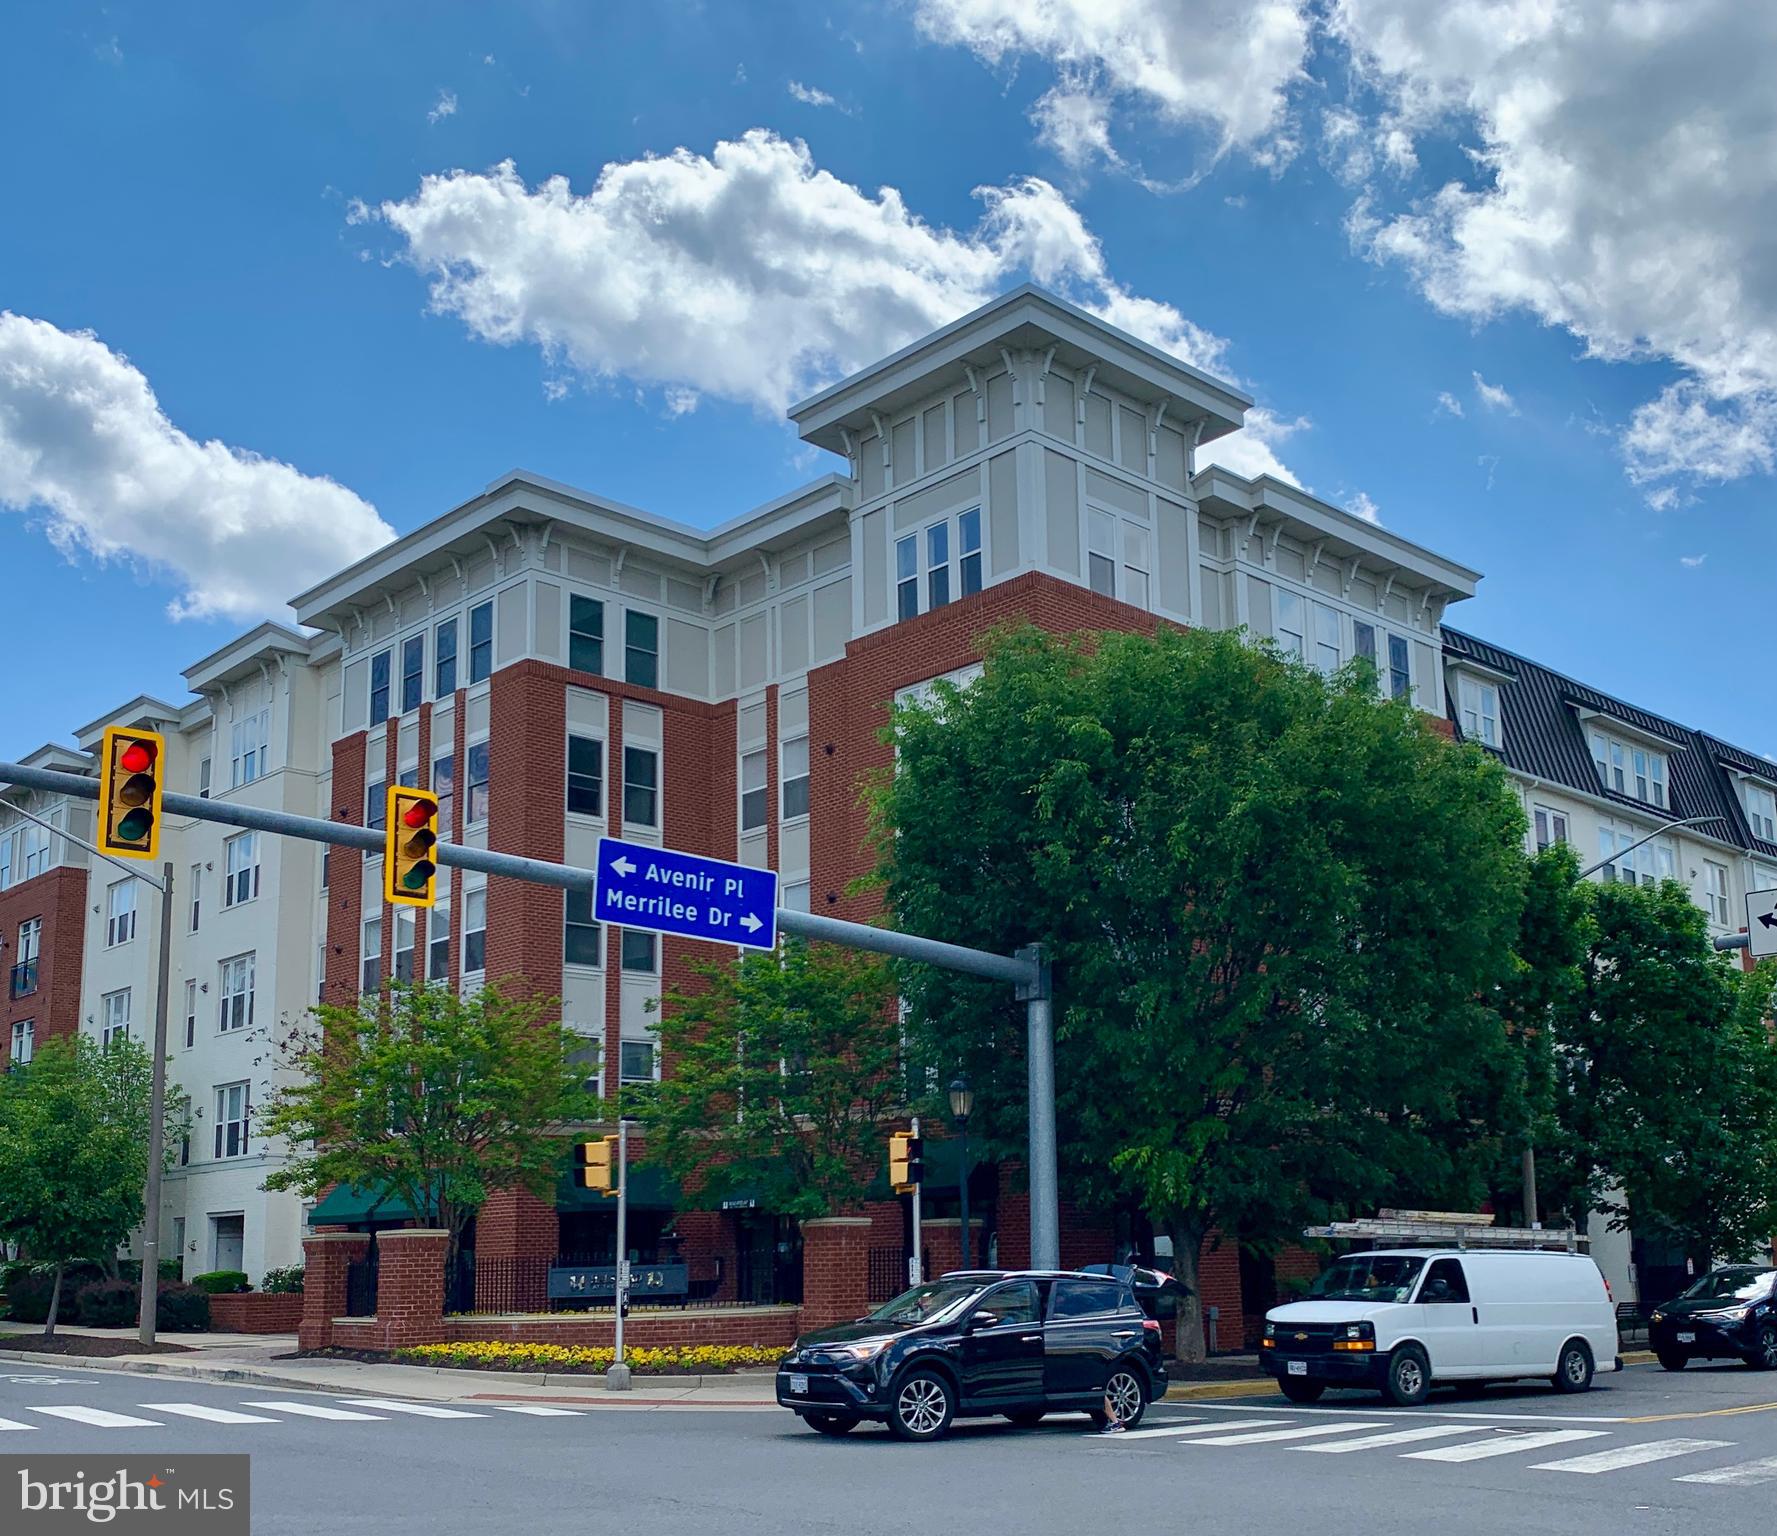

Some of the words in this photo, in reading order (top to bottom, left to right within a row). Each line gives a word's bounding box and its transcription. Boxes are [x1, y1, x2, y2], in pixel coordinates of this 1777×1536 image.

[645, 864, 714, 892] Avenir
[725, 878, 744, 898] Pl
[606, 889, 698, 921] Merrilee
[708, 907, 732, 927] Dr
